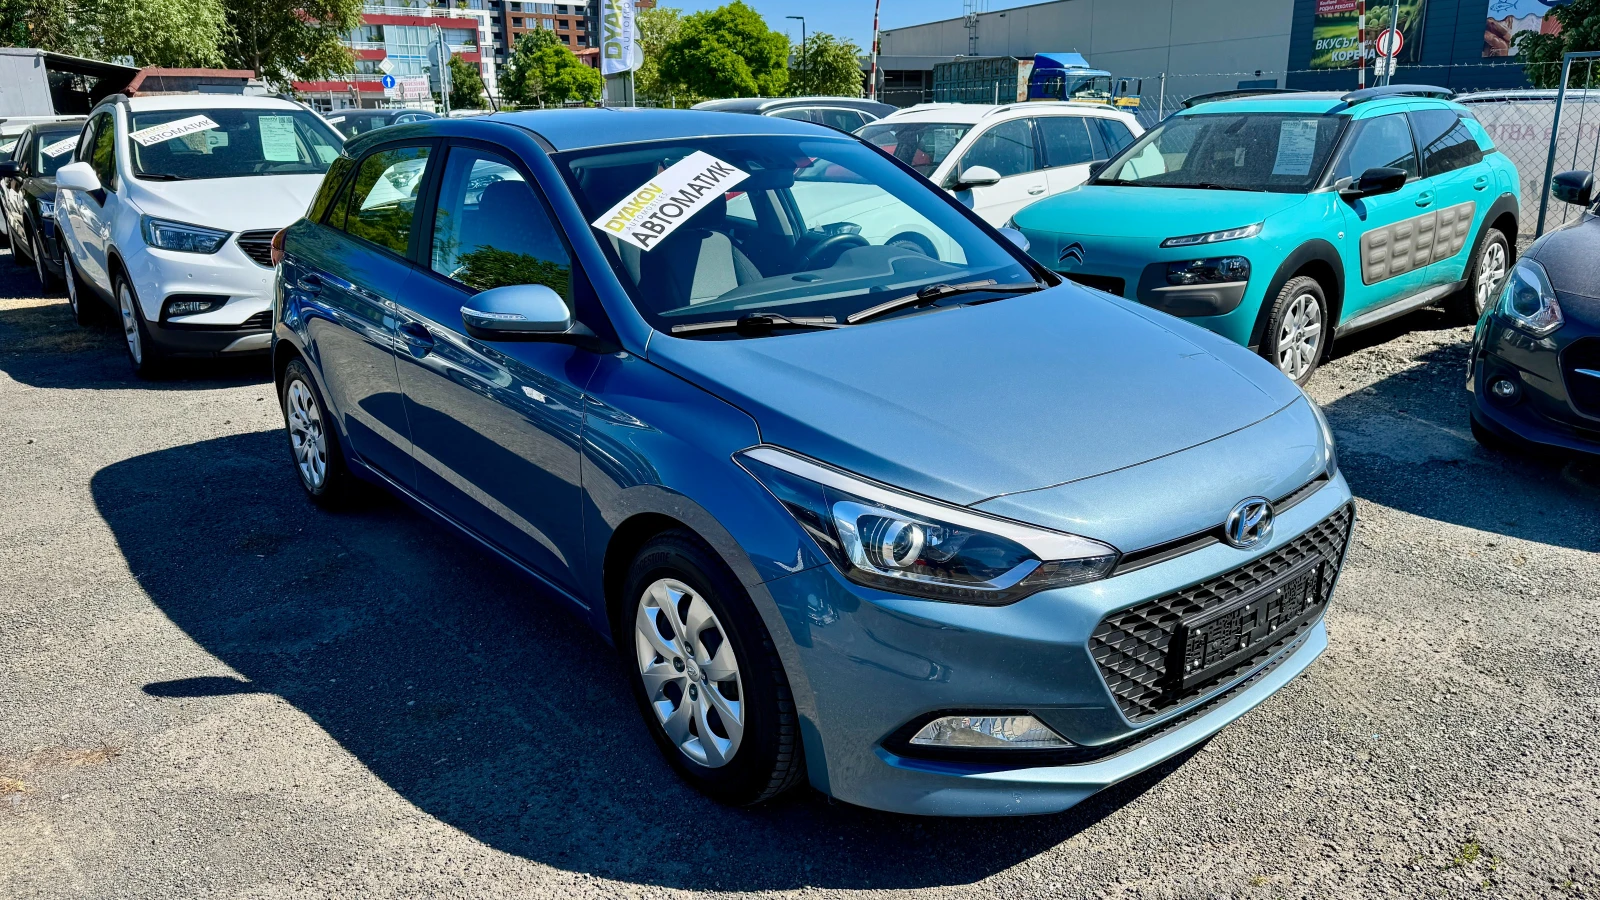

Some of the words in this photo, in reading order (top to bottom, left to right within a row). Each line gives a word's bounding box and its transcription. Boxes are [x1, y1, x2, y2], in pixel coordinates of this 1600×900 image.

[623, 2, 631, 51] AUTOMO
[1315, 37, 1356, 50] ВКУСЪТ
[142, 119, 214, 145] АВТОМАТИК
[604, 182, 663, 232] DYAKOV
[626, 192, 669, 231] AUTOMOBILES
[631, 161, 736, 248] АВТОМАТИК
